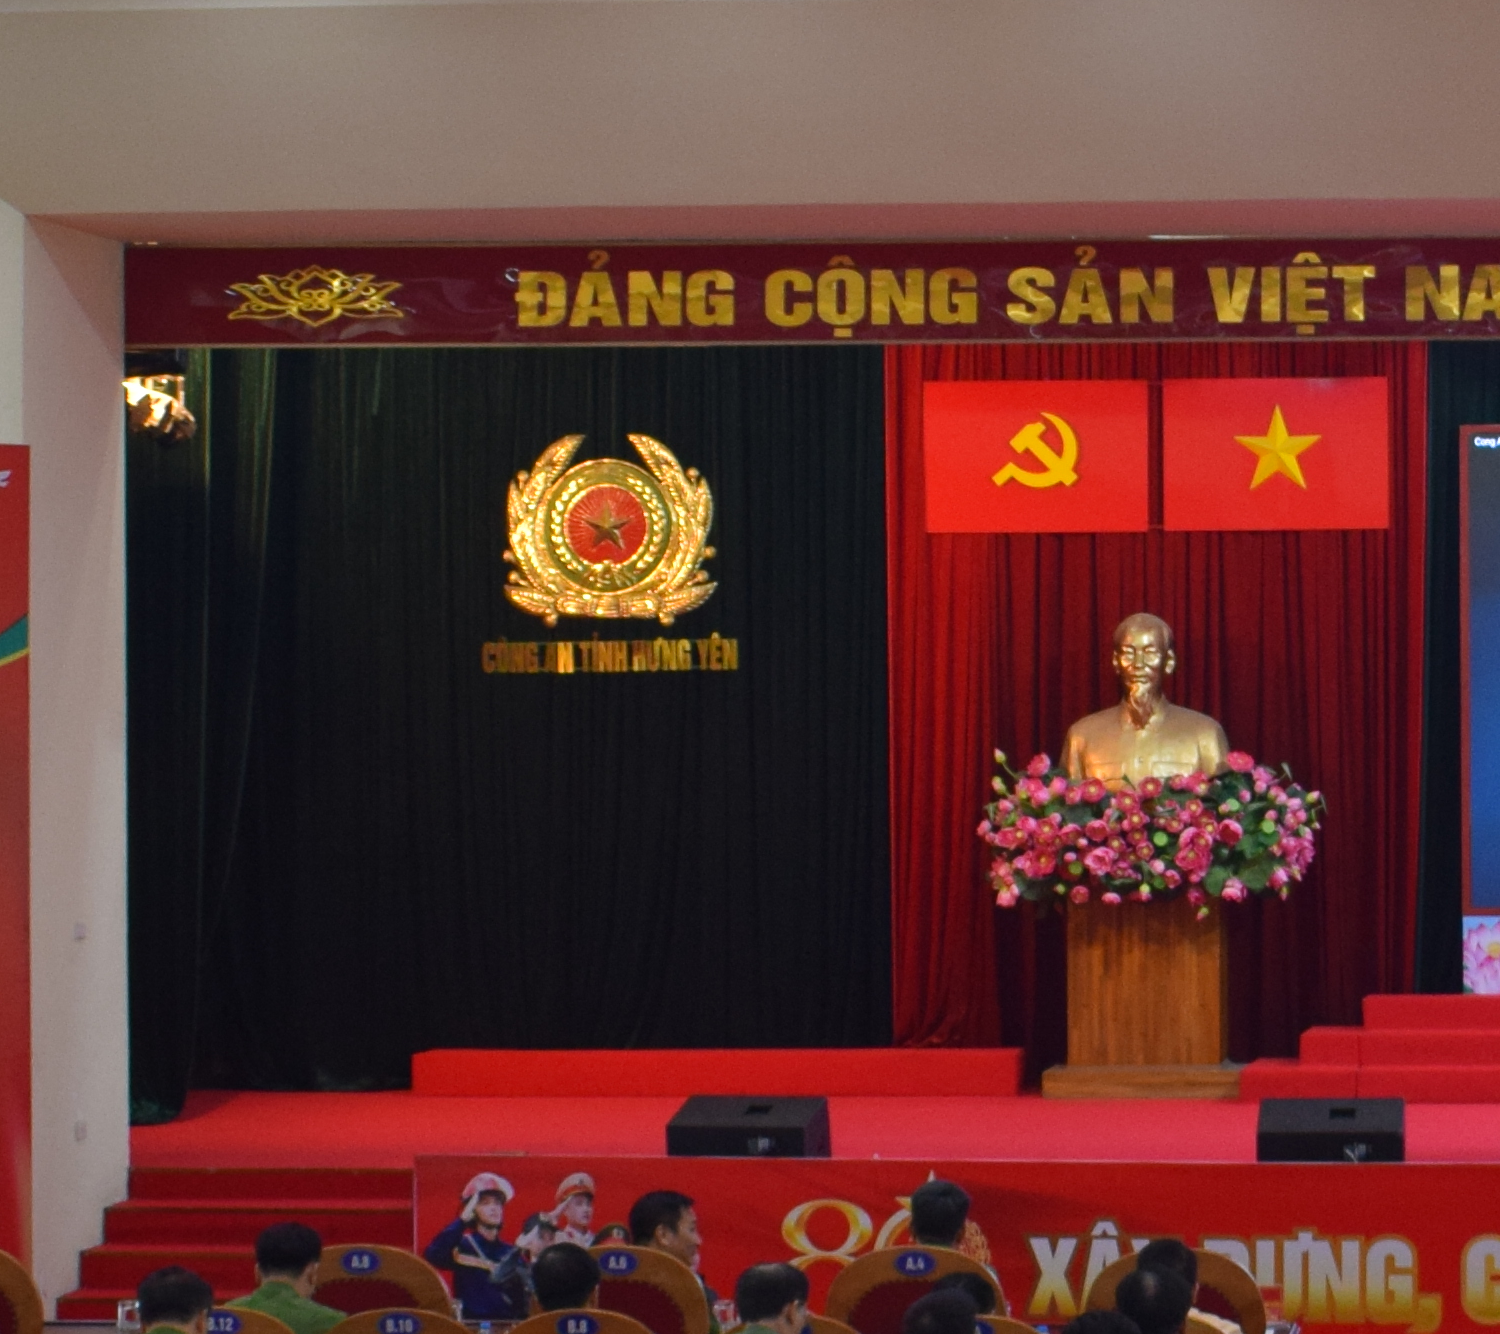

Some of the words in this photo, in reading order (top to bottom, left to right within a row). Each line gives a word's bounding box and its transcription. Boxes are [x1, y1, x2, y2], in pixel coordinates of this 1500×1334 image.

[514, 248, 736, 329] ĐẢNG
[764, 256, 978, 338] CỘNG
[1005, 244, 1175, 327] SẢN
[1208, 250, 1376, 334] VIỆT
[482, 636, 538, 673] CÔNG
[545, 642, 573, 673] AN
[580, 632, 628, 672] TỈNH
[632, 636, 691, 671] HƯNG
[697, 632, 738, 670] YÊN
